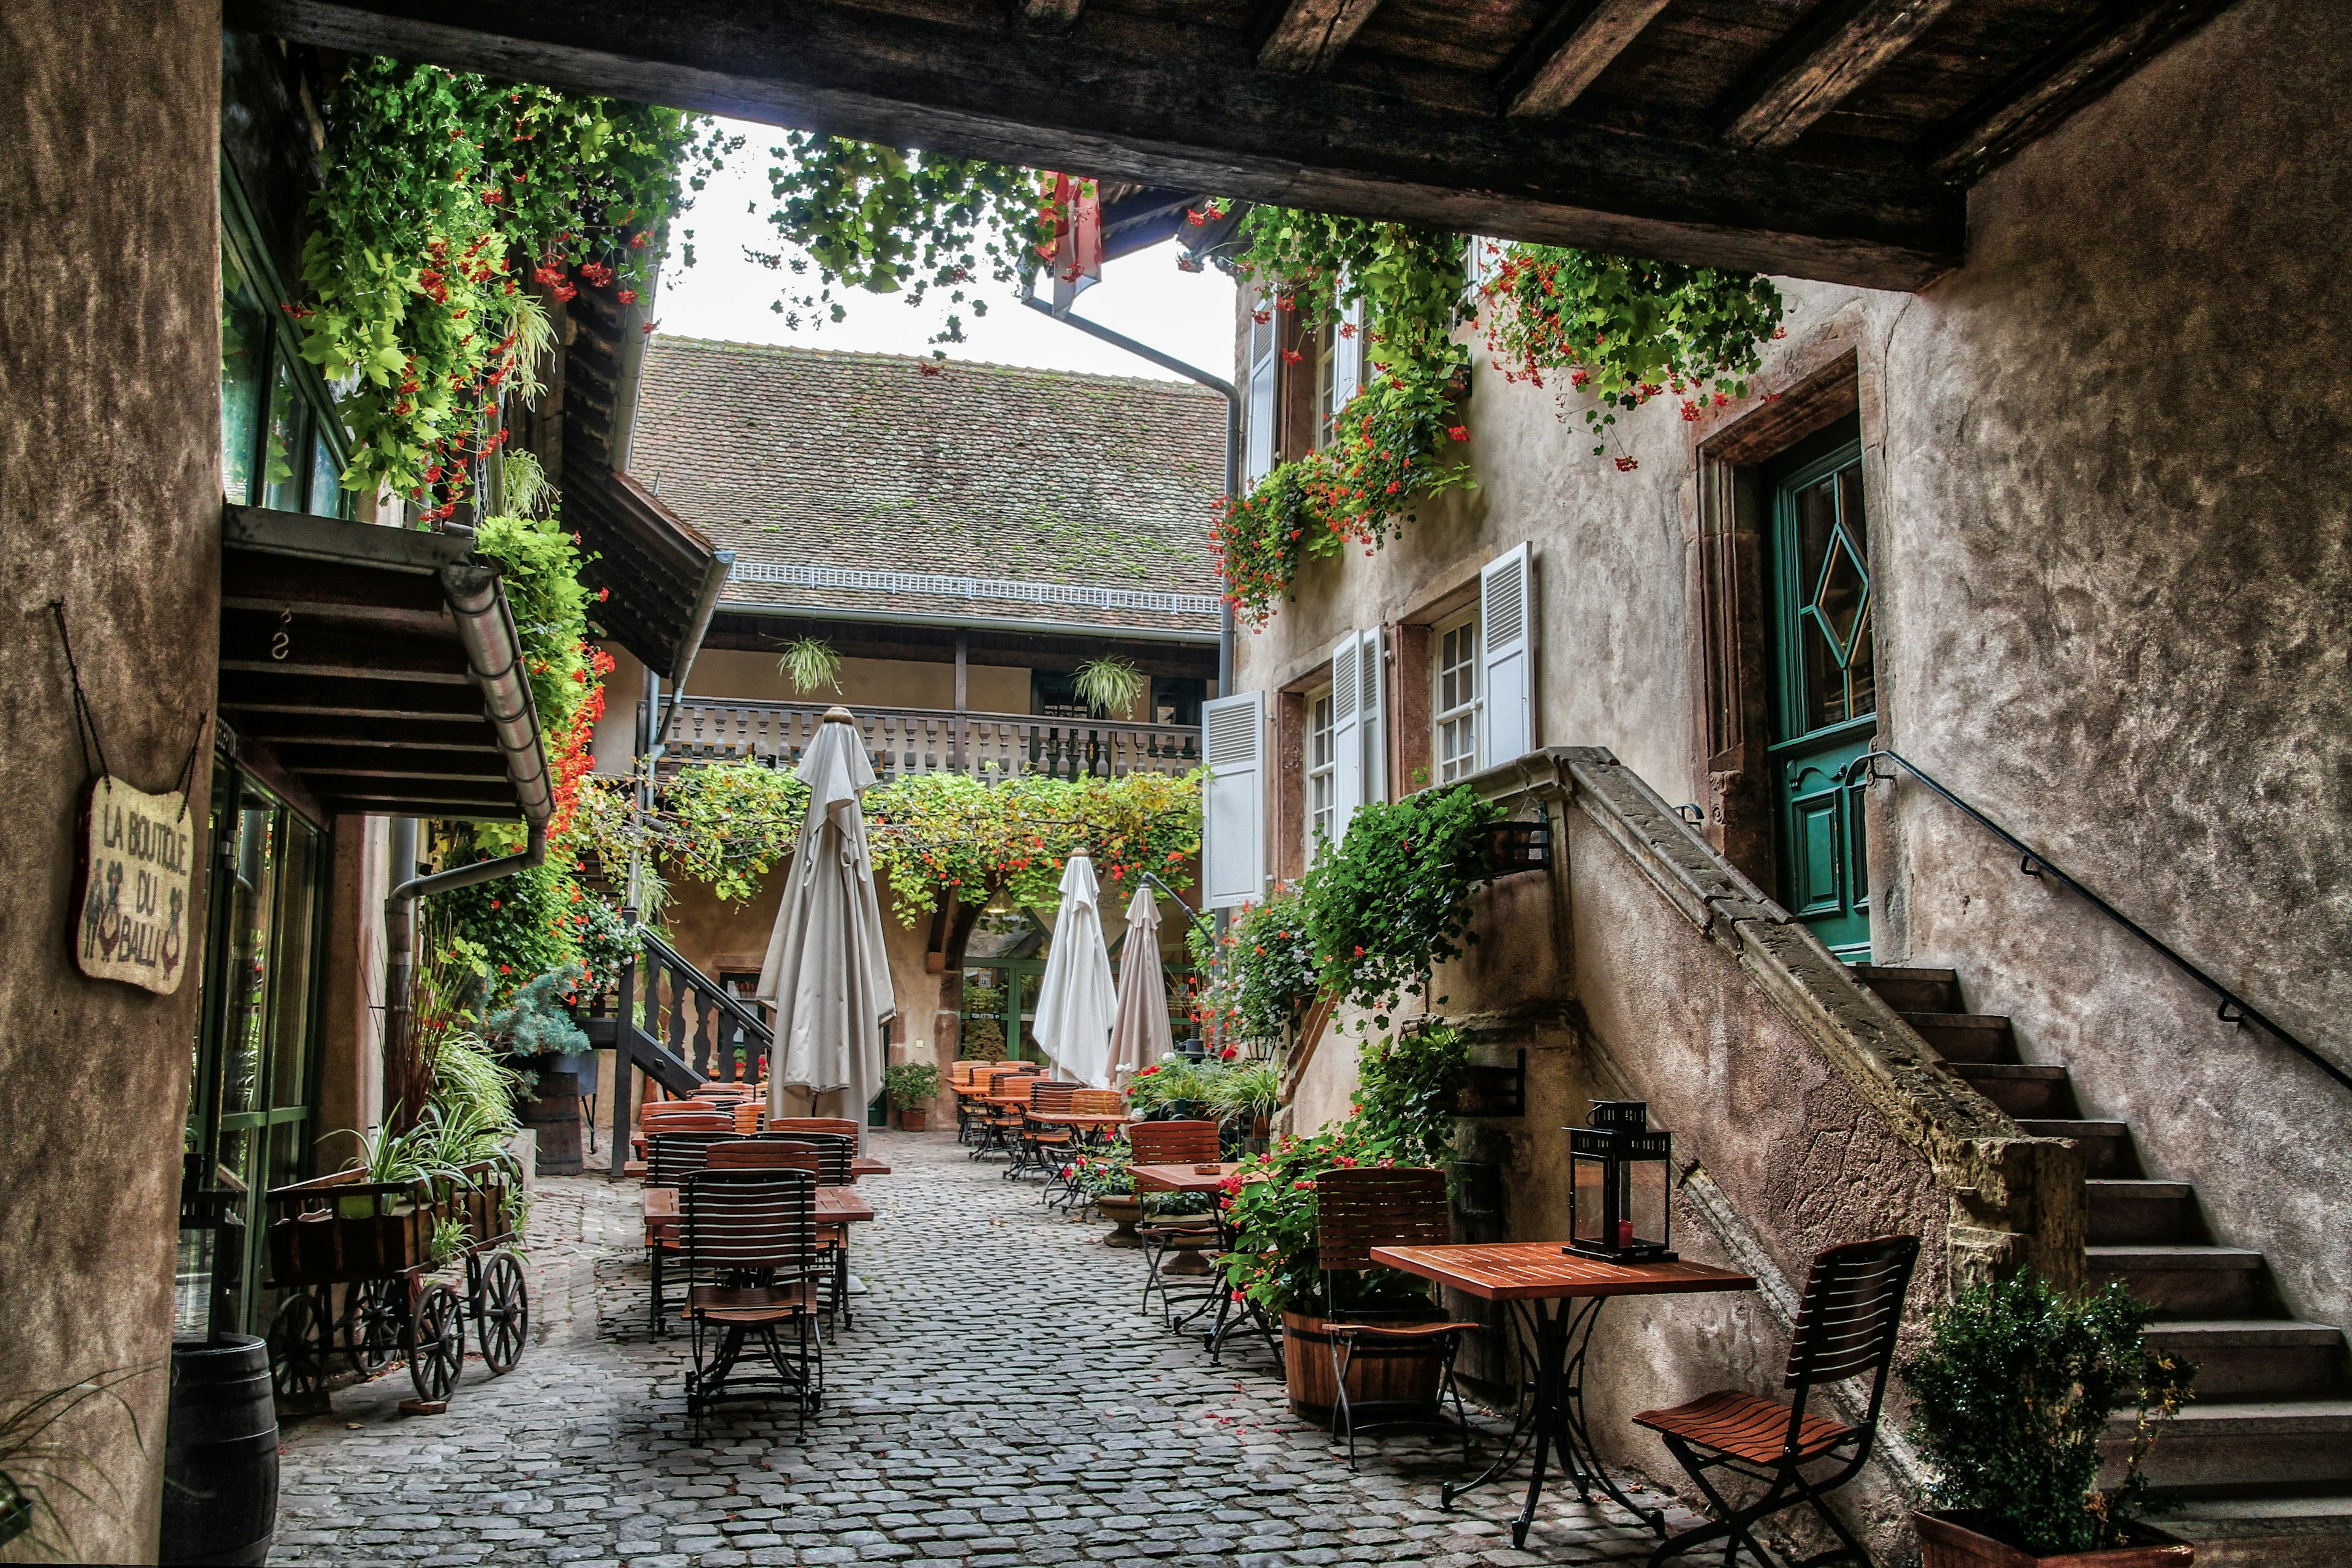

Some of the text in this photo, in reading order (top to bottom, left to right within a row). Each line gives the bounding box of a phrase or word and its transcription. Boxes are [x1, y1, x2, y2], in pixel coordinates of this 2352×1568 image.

[104, 803, 187, 876] LA BOUTIQUE
[137, 869, 157, 916] DU
